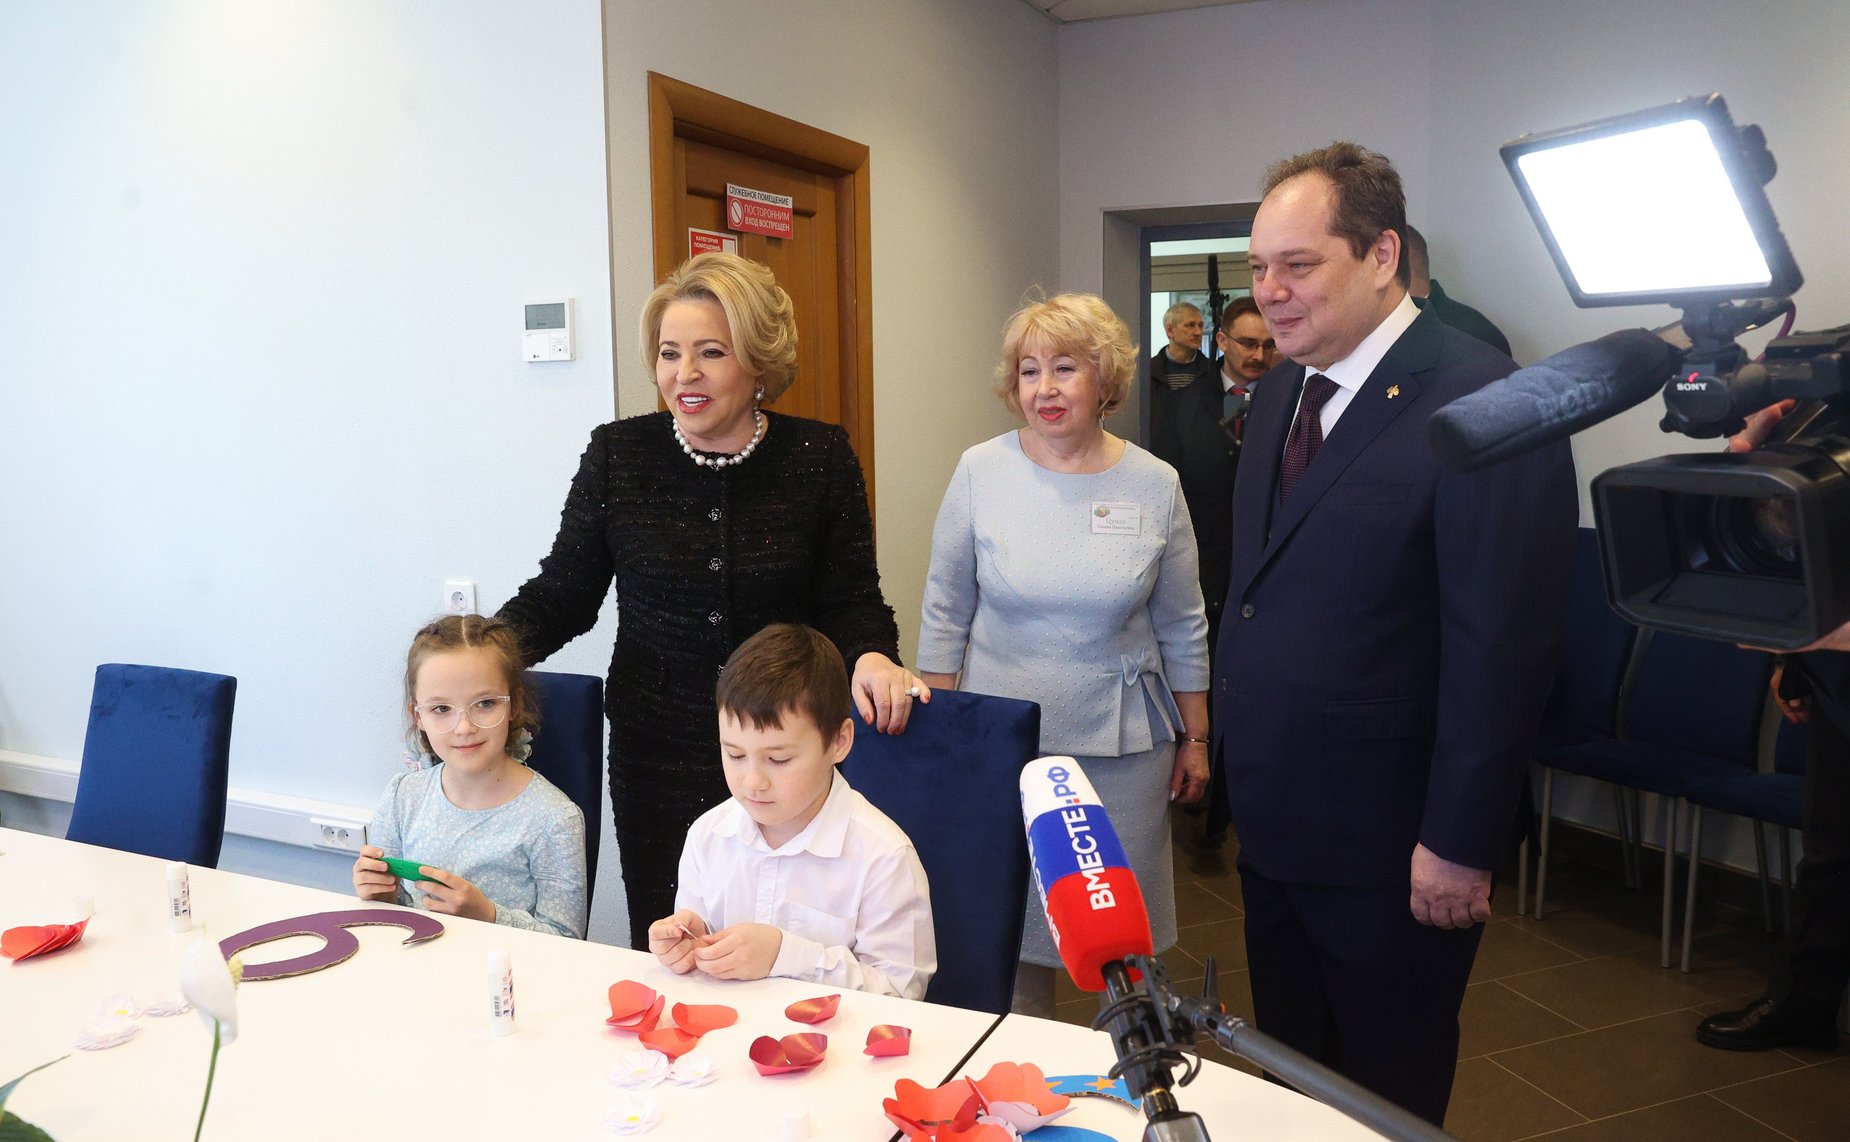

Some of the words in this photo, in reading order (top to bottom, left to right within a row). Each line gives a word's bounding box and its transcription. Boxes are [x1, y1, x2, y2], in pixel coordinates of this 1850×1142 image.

[728, 186, 757, 199] СЛУЖЕБНОЕ
[757, 191, 789, 205] ПОМЕЩЕНИЕ
[744, 204, 790, 221] ПОСТОРОННИМ
[745, 216, 758, 227] ВХОД
[759, 219, 790, 232] ВОСПРЕЩЕН
[1676, 382, 1707, 391] SONY
